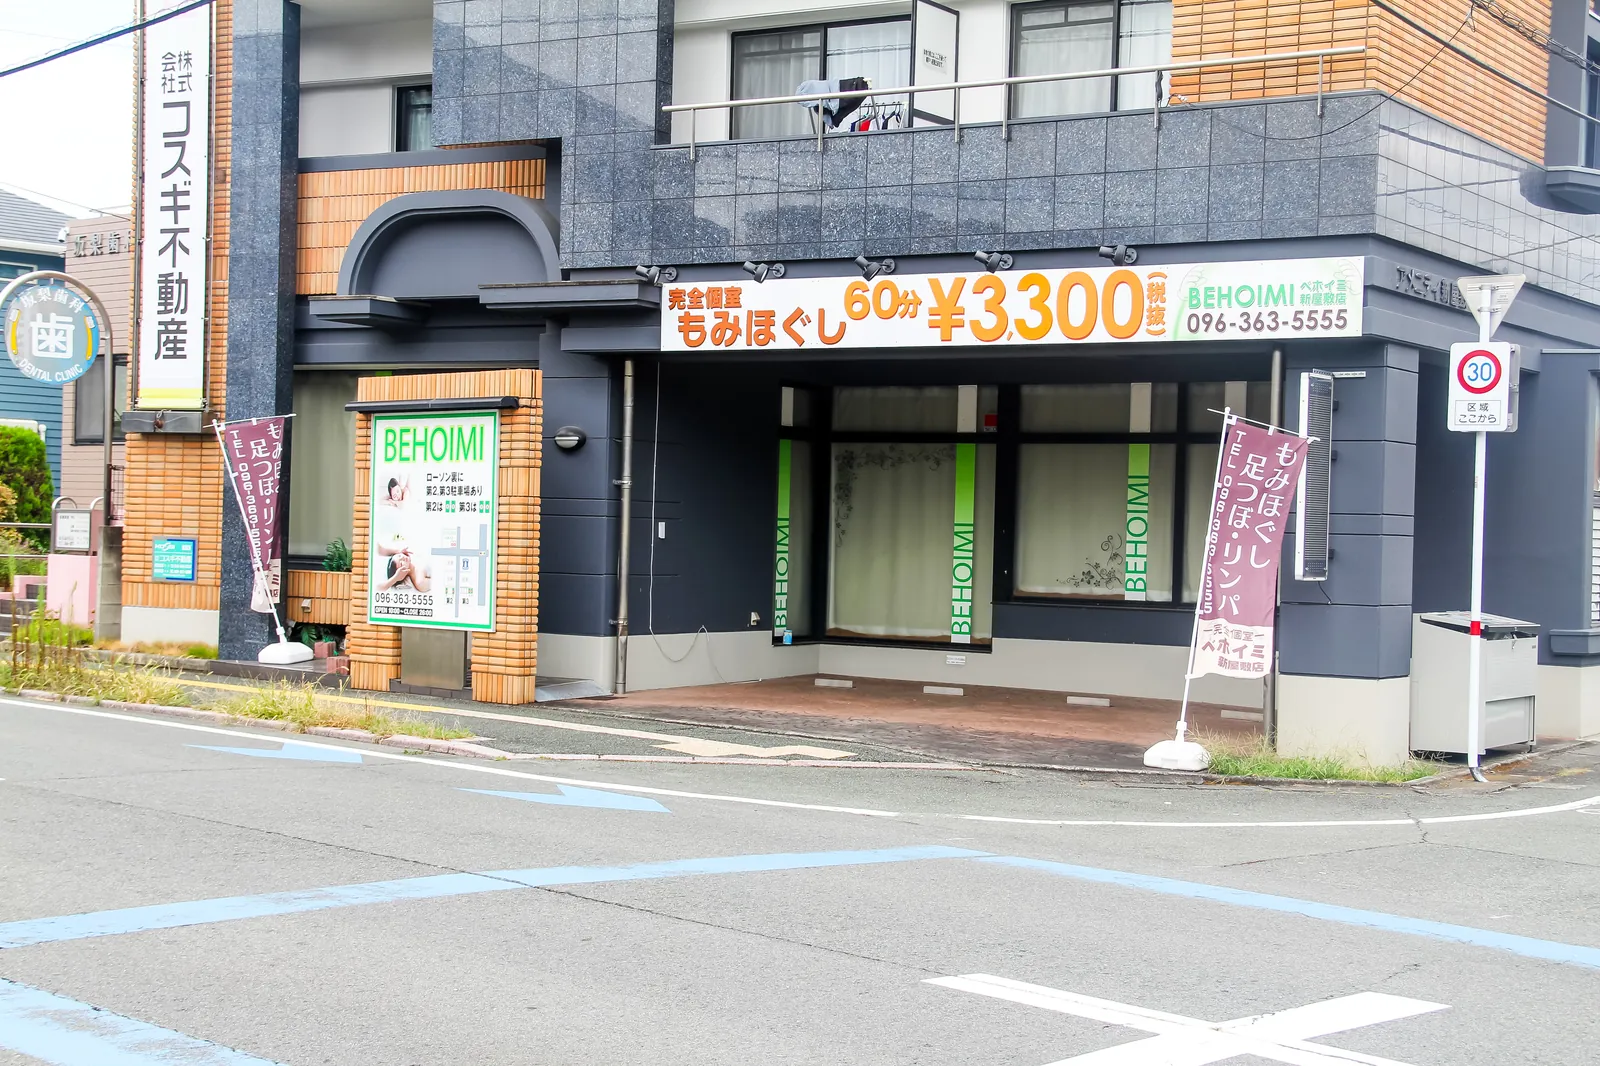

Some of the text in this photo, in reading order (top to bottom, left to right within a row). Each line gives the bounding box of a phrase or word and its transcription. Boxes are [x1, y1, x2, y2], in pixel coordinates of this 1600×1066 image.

[155, 100, 192, 362] コスギ不動産
[668, 286, 742, 310] 完全個室
[844, 279, 922, 320] 60分
[1188, 284, 1295, 309] BEHOIMI
[29, 312, 75, 359] 歯
[677, 306, 847, 347] もみほぐし
[1187, 308, 1348, 334] 096-363-5555
[19, 357, 84, 382] DENTAL CLINIC
[1467, 362, 1492, 382] 30
[1458, 414, 1497, 423] ここから
[1467, 402, 1489, 412] 区域
[230, 430, 246, 458] TEL
[384, 424, 485, 463] BEHOIMI
[1227, 430, 1247, 469] TEL
[426, 471, 464, 482] ローソン裏に
[1249, 442, 1297, 569] もみほぐし
[1125, 475, 1149, 593] BEHOIMI
[774, 517, 790, 629] BEHOIMI
[951, 522, 974, 636] BEHOIMI
[375, 592, 434, 606] 096-363-5555
